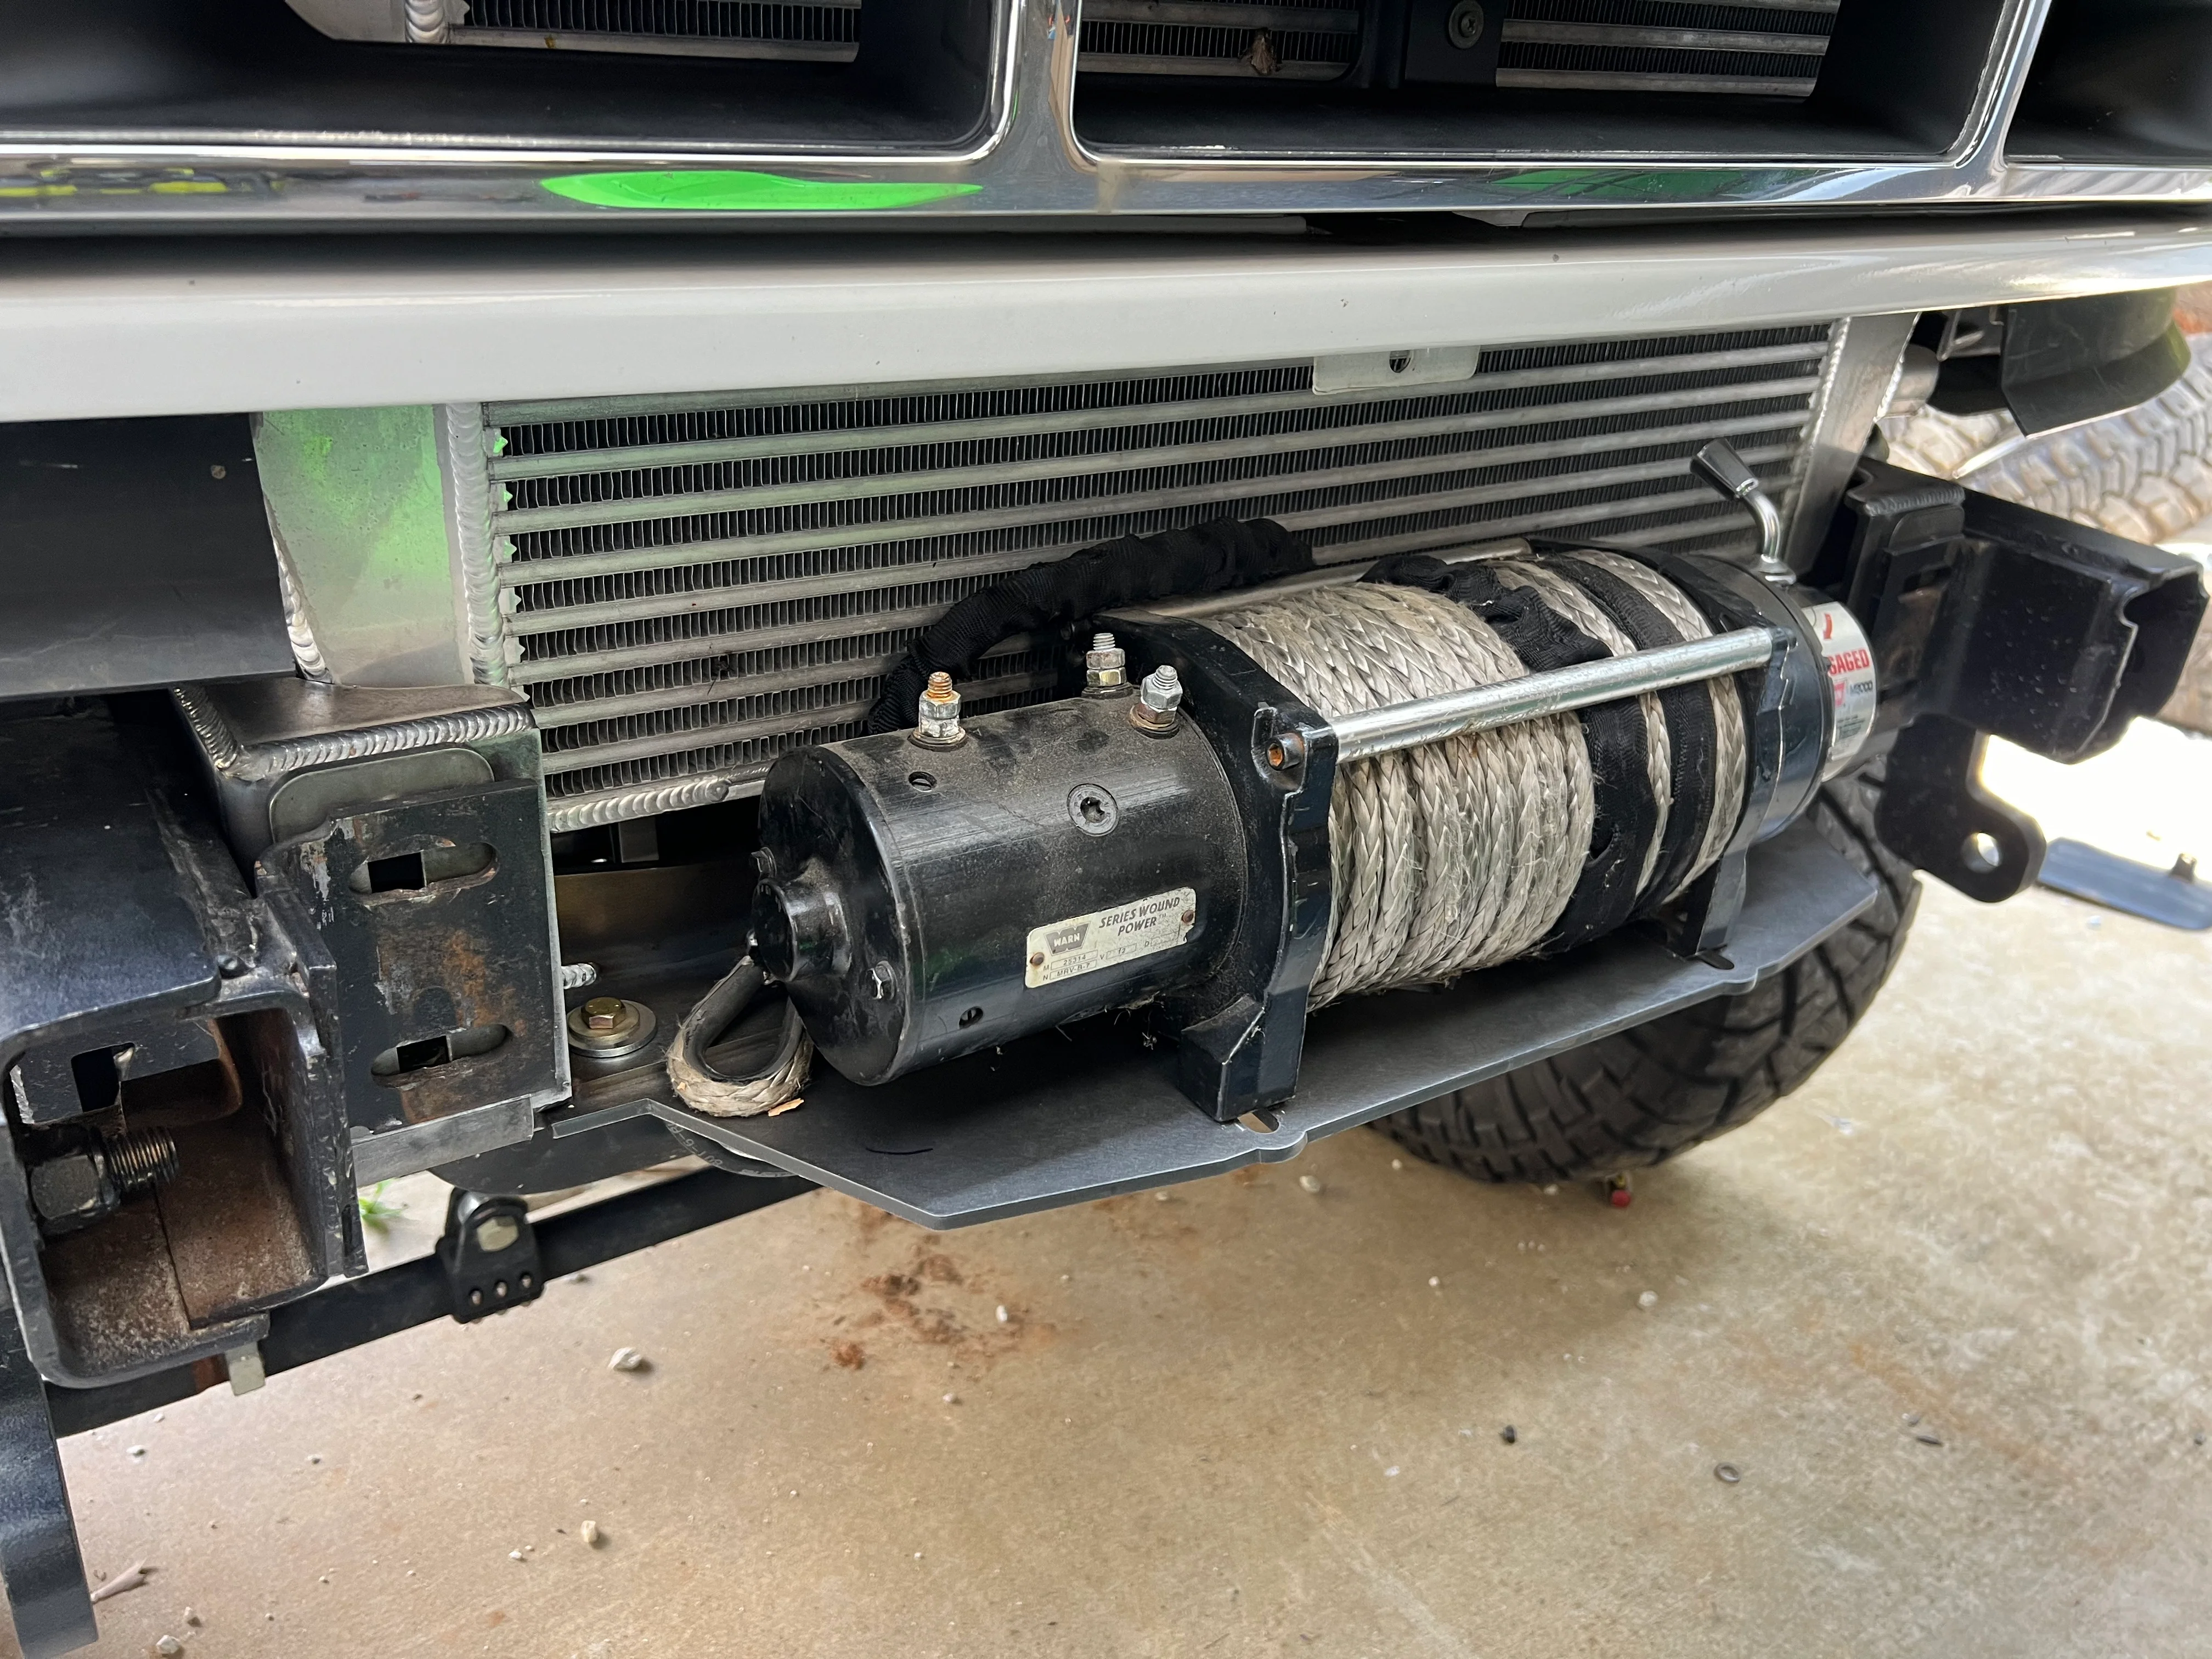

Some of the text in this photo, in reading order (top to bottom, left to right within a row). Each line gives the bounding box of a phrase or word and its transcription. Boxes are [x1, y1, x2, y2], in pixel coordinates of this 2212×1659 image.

[1098, 896, 1180, 928] SERIES WOUND
[1053, 932, 1081, 947] WARN
[1063, 954, 1086, 966] 25314
